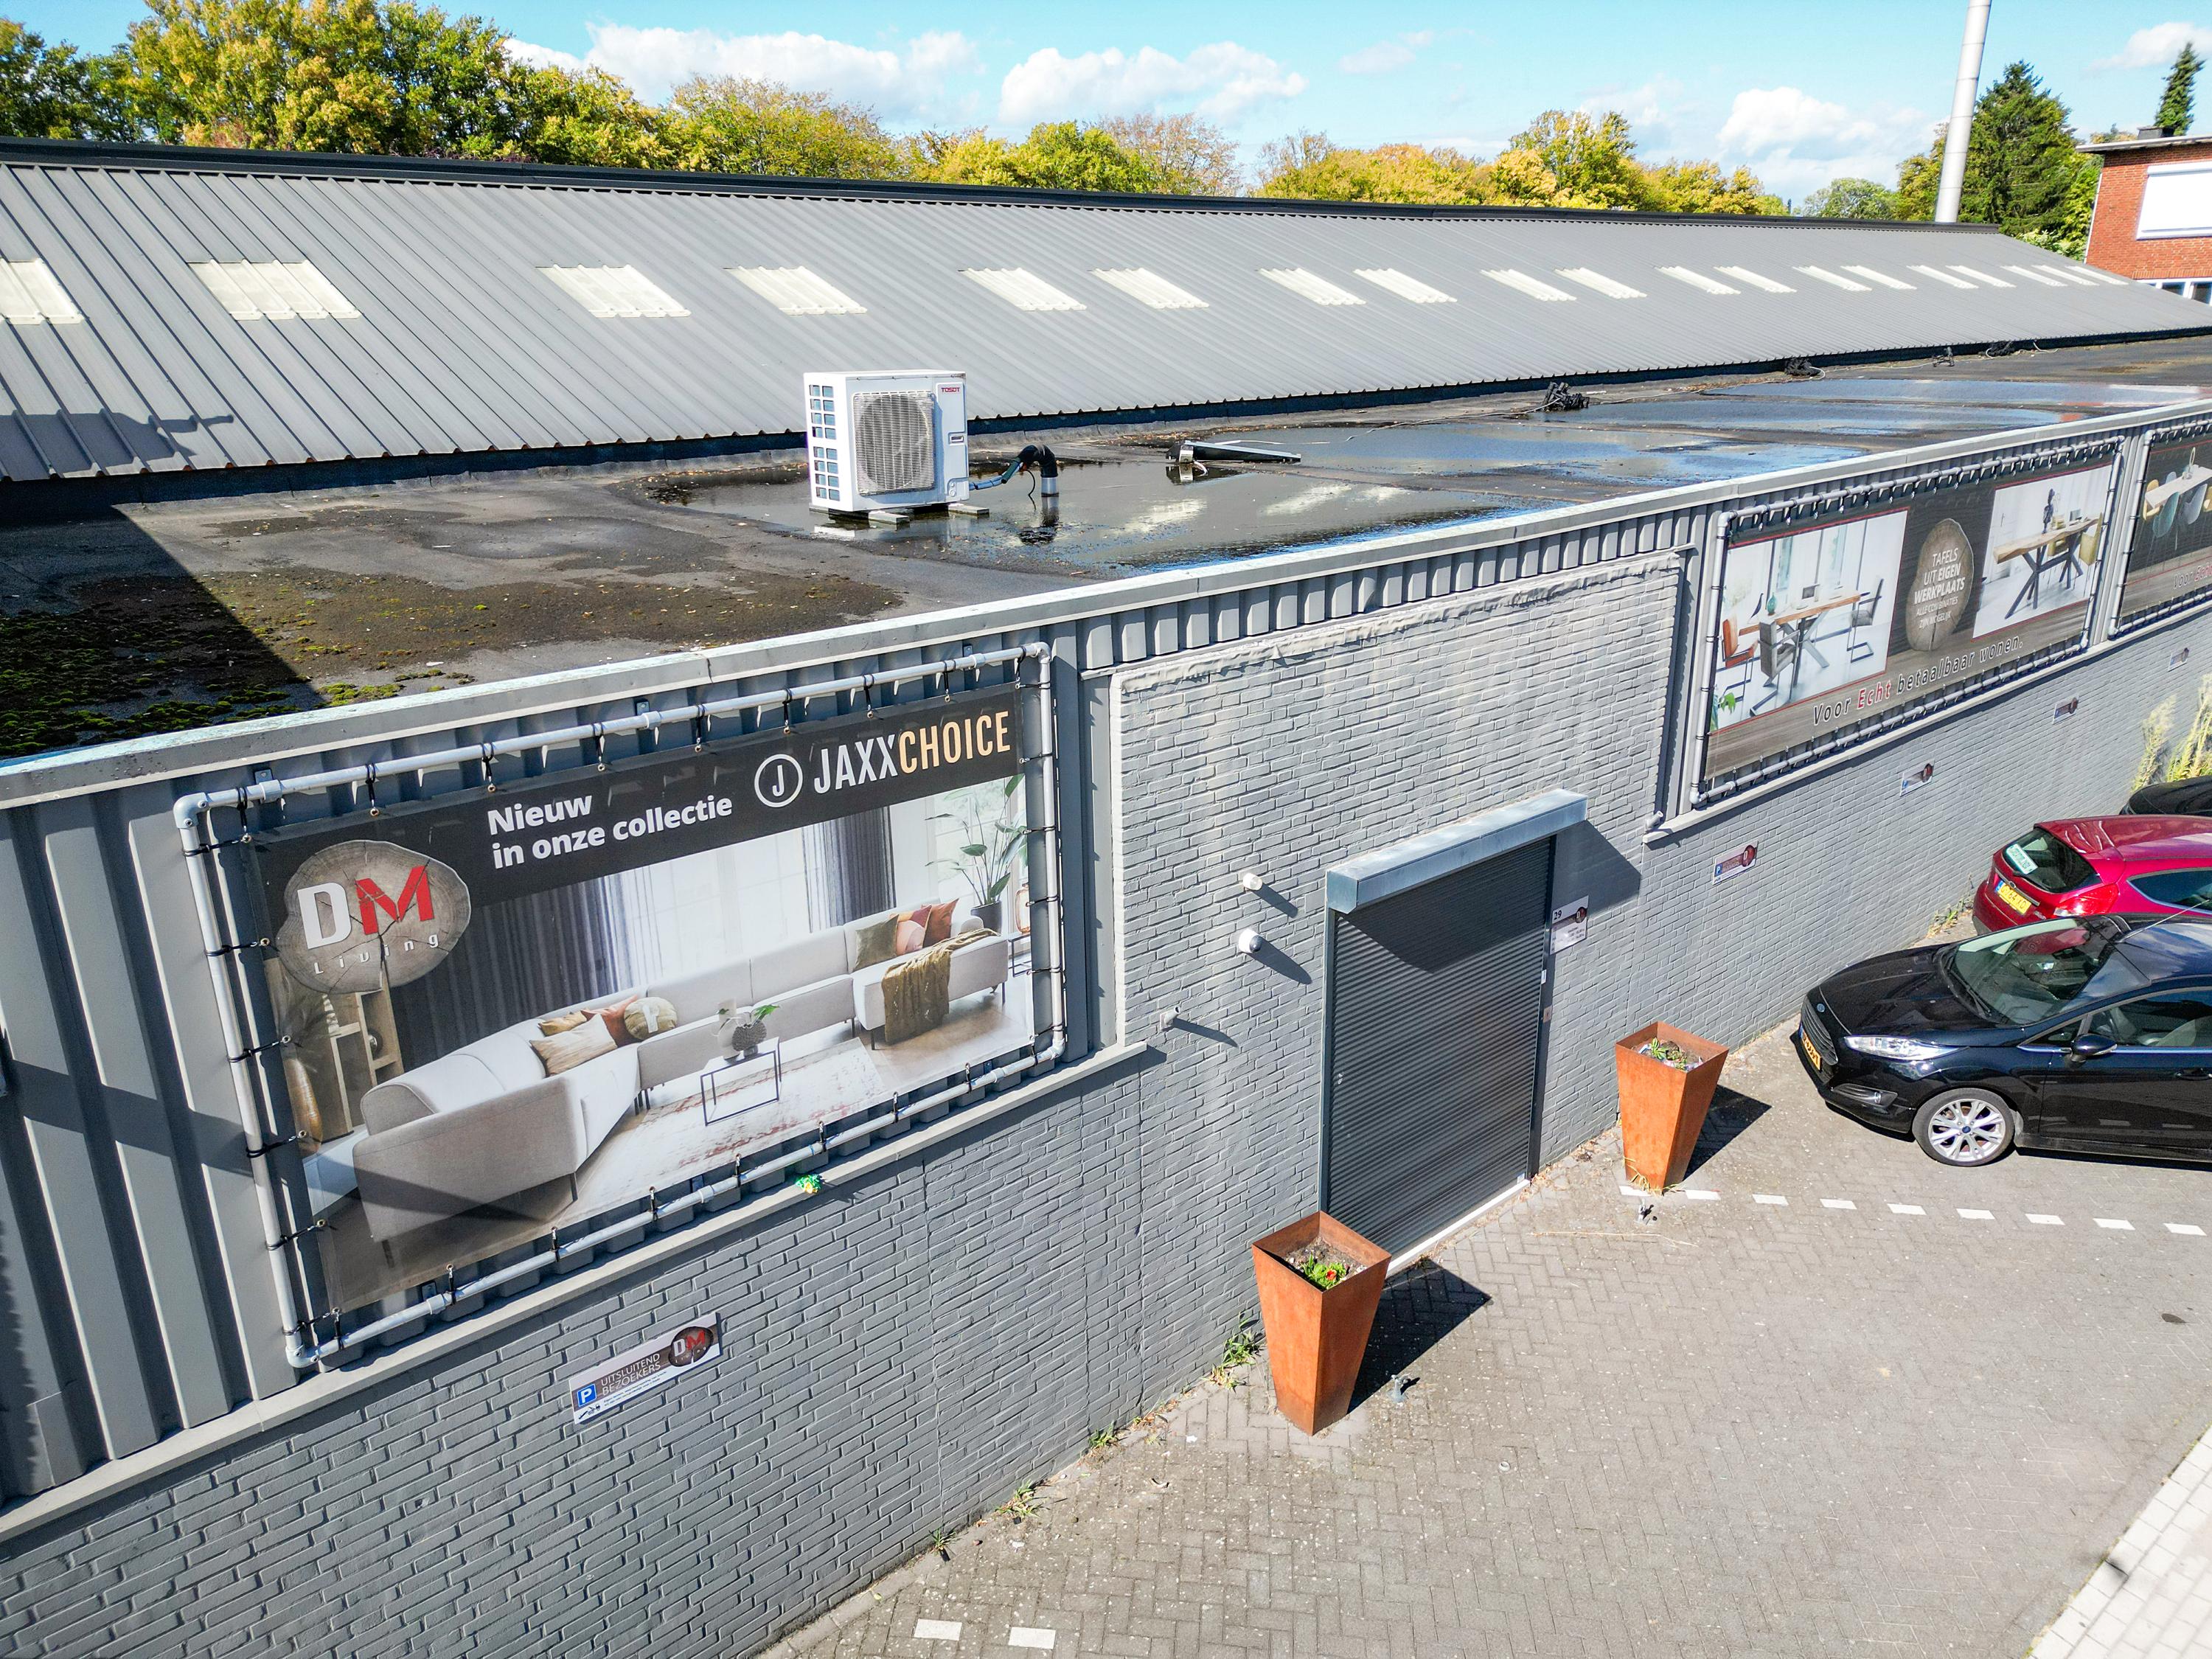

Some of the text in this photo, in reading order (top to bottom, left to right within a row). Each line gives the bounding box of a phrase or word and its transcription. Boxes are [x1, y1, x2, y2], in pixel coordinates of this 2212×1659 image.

[1933, 548, 1958, 566] TAFELS
[1924, 562, 1961, 585] UIT EIGEN
[1914, 577, 1965, 605] WERKPLAATS
[1813, 635, 2023, 726] Voor Echt betaalbaar wonen.
[814, 711, 1011, 794] JAXXCHOICE
[772, 765, 785, 797] J
[487, 796, 592, 835] Nieuw
[492, 795, 732, 869] in onze collectie
[297, 865, 435, 950] DM
[1554, 910, 1562, 920] 29
[673, 1329, 706, 1357] DM
[601, 1353, 660, 1386] UITSLUITEND
[602, 1361, 661, 1396] BEZOEKERS
[580, 1388, 592, 1403] P
